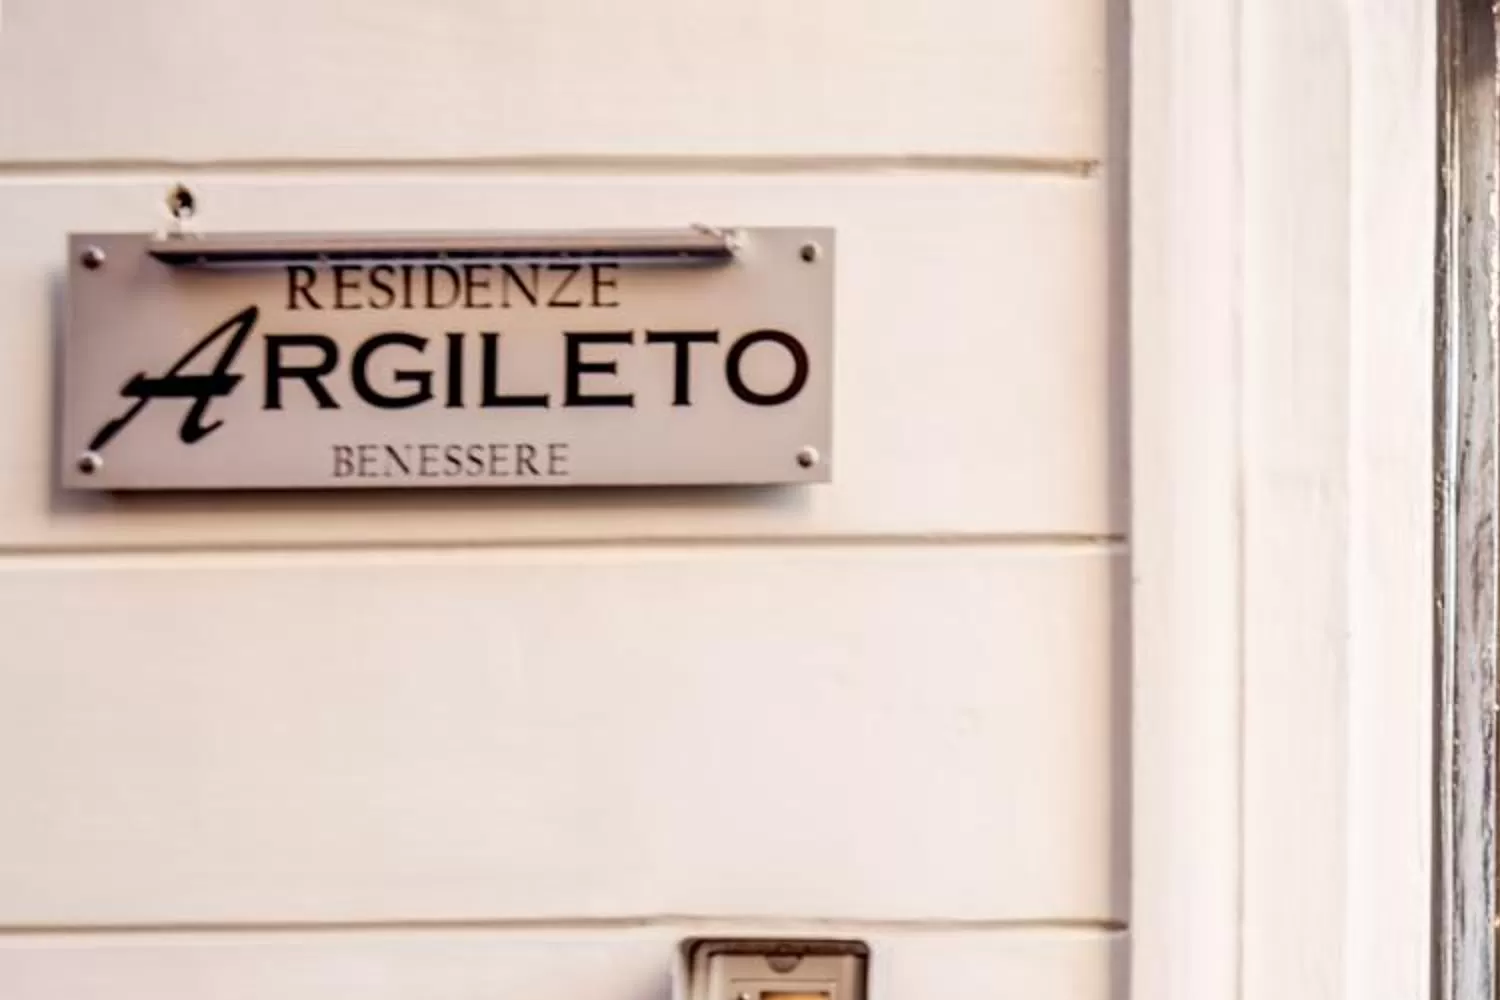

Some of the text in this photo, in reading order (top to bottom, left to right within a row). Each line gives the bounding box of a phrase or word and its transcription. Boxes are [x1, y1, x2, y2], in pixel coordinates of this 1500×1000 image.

[285, 262, 620, 311] RESIDENZE
[89, 305, 809, 450] ARGILETO
[332, 443, 570, 477] BENESSERE
